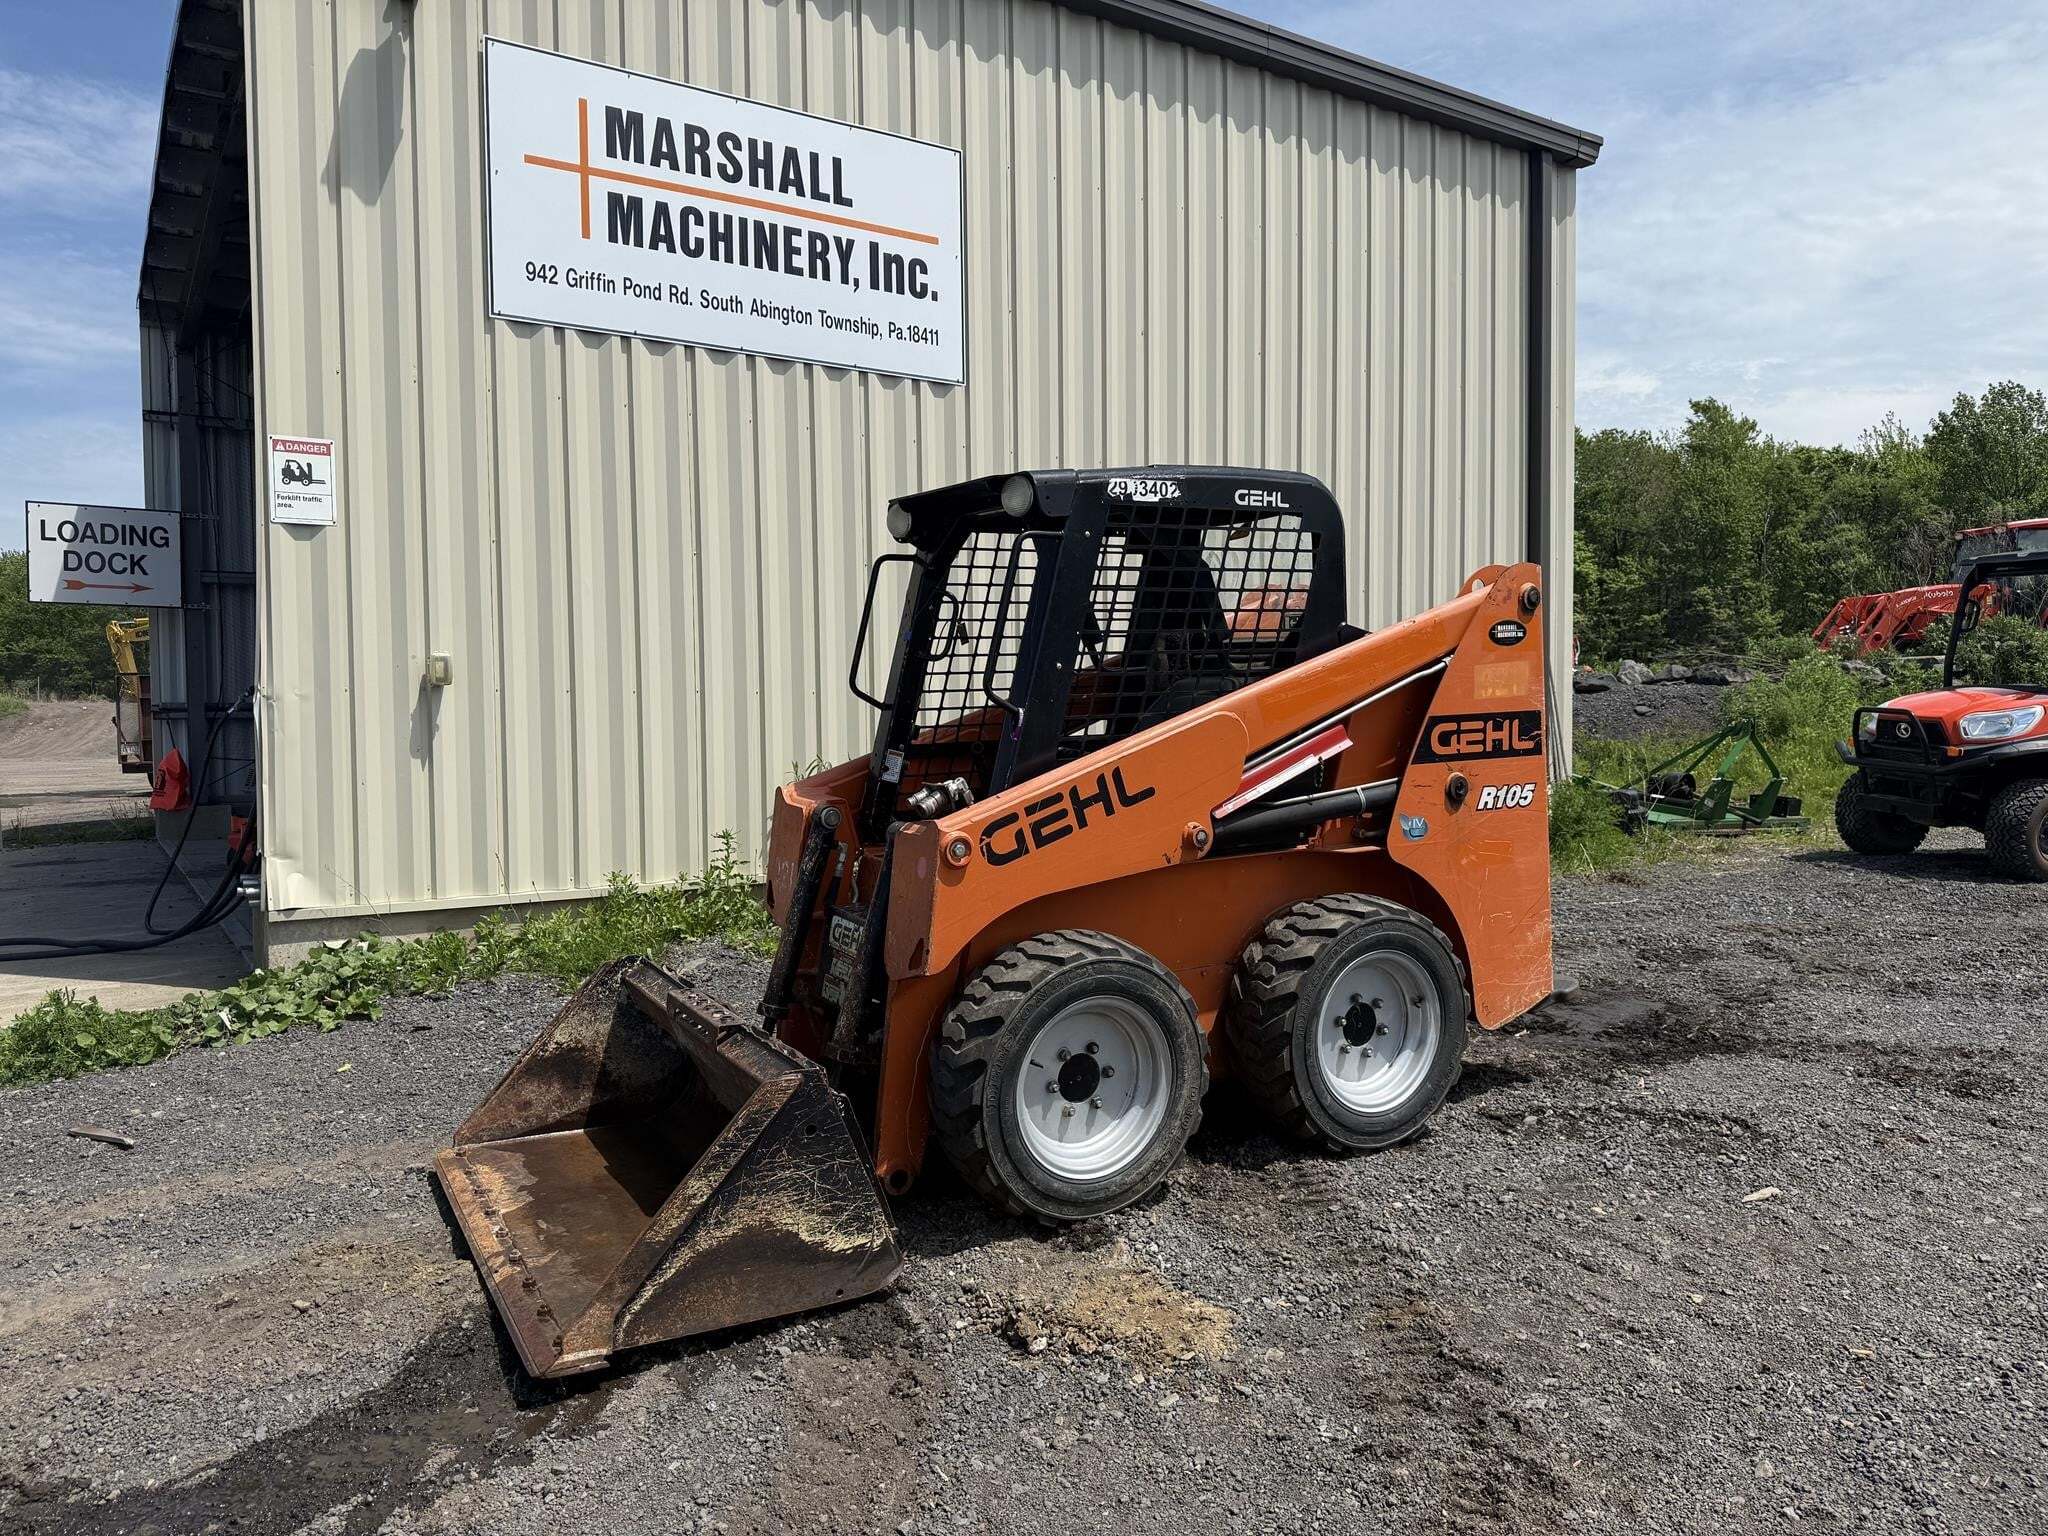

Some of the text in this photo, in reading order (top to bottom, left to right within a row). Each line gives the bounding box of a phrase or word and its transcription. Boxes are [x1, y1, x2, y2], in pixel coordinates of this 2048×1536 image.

[604, 105, 854, 209] MARSHALL
[607, 190, 939, 302] MACHINERY, Inc.
[525, 261, 559, 285] 942
[565, 267, 616, 294] Griffin
[623, 276, 662, 302] Pond
[668, 283, 693, 306] Rd.
[699, 289, 744, 315] South
[749, 297, 813, 327] Abington
[817, 309, 883, 341] Township,
[285, 442, 327, 454] DANGER
[276, 493, 323, 503] Forklift traffic
[1234, 489, 1290, 508] GEHL
[39, 518, 170, 549] LOADING
[62, 549, 149, 576] DOCK
[1430, 718, 1535, 756] GEHL
[1476, 784, 1535, 811] R105
[978, 766, 1156, 867] GEHL
